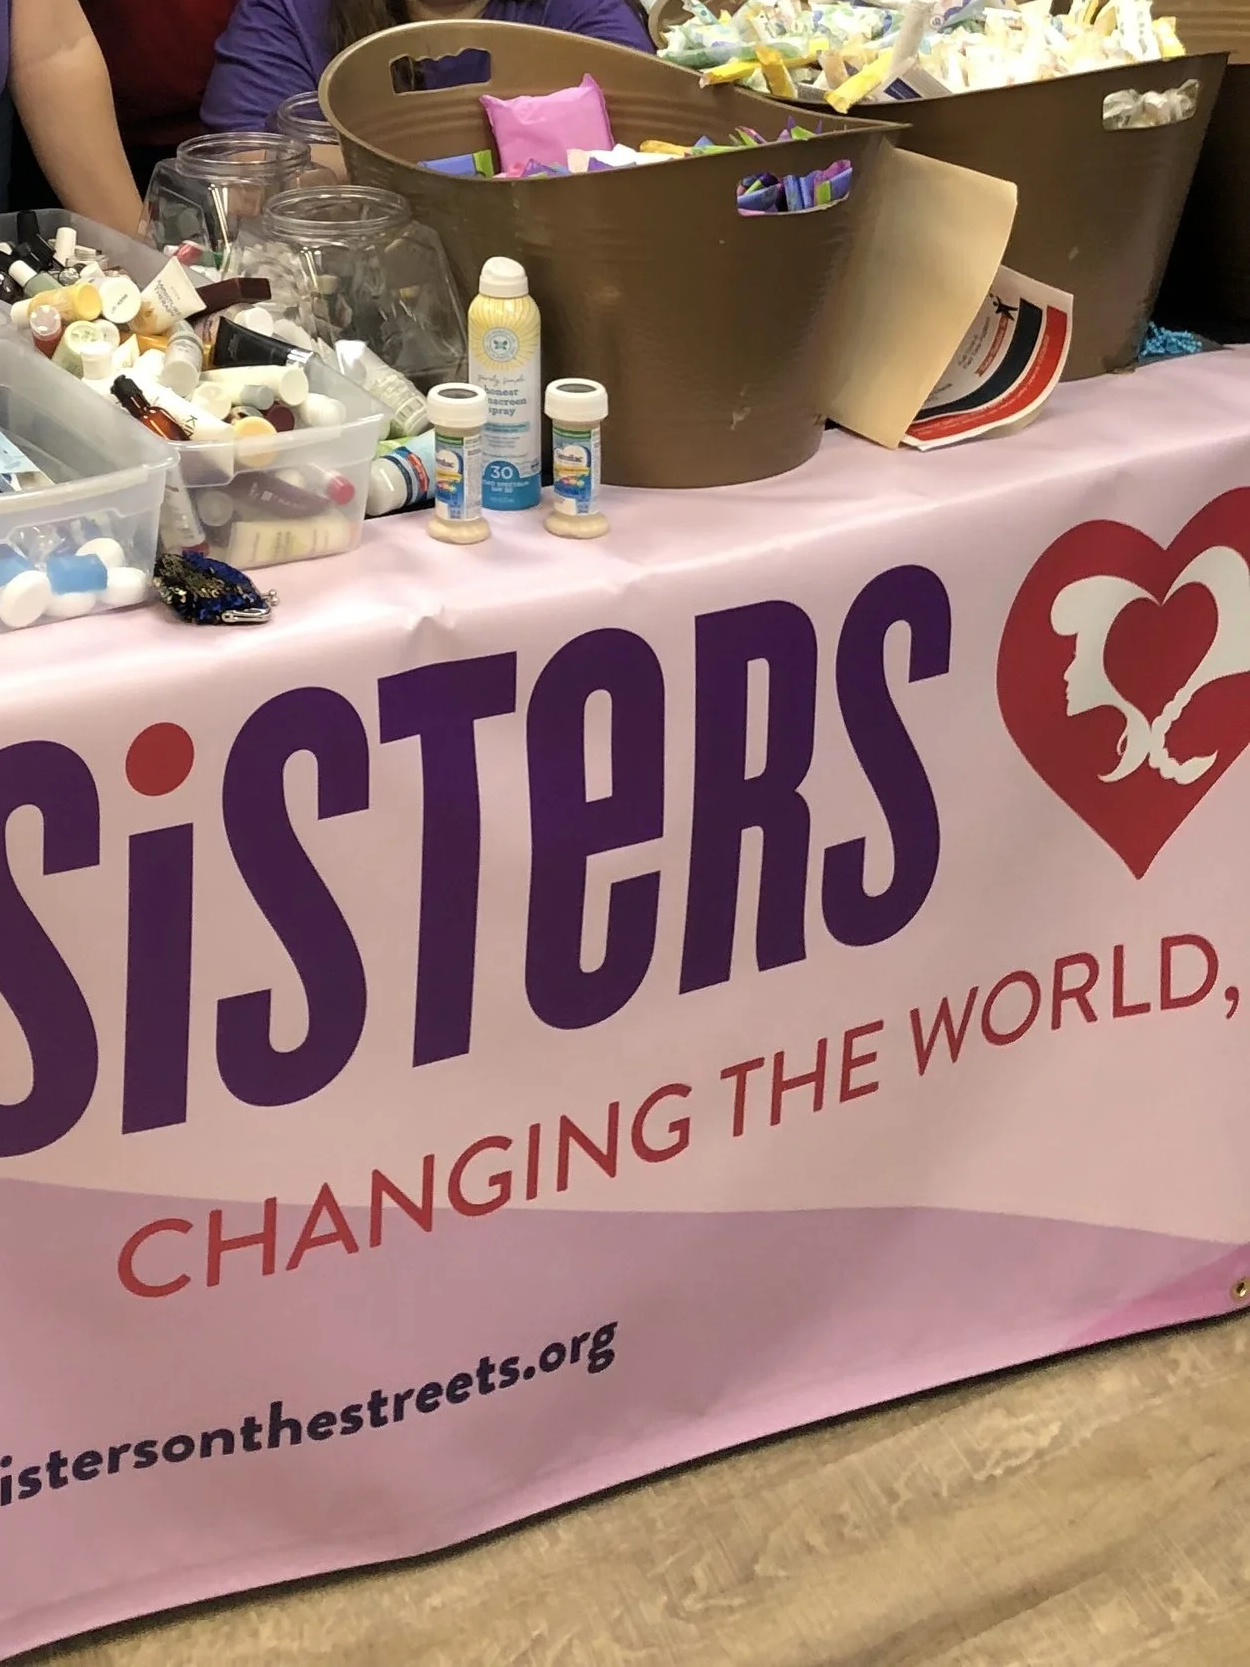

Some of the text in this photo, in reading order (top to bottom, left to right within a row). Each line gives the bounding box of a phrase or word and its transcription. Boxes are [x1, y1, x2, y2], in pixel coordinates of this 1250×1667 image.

[490, 465, 514, 479] 30
[117, 933, 1241, 1297] CHANGING THE WORLD,
